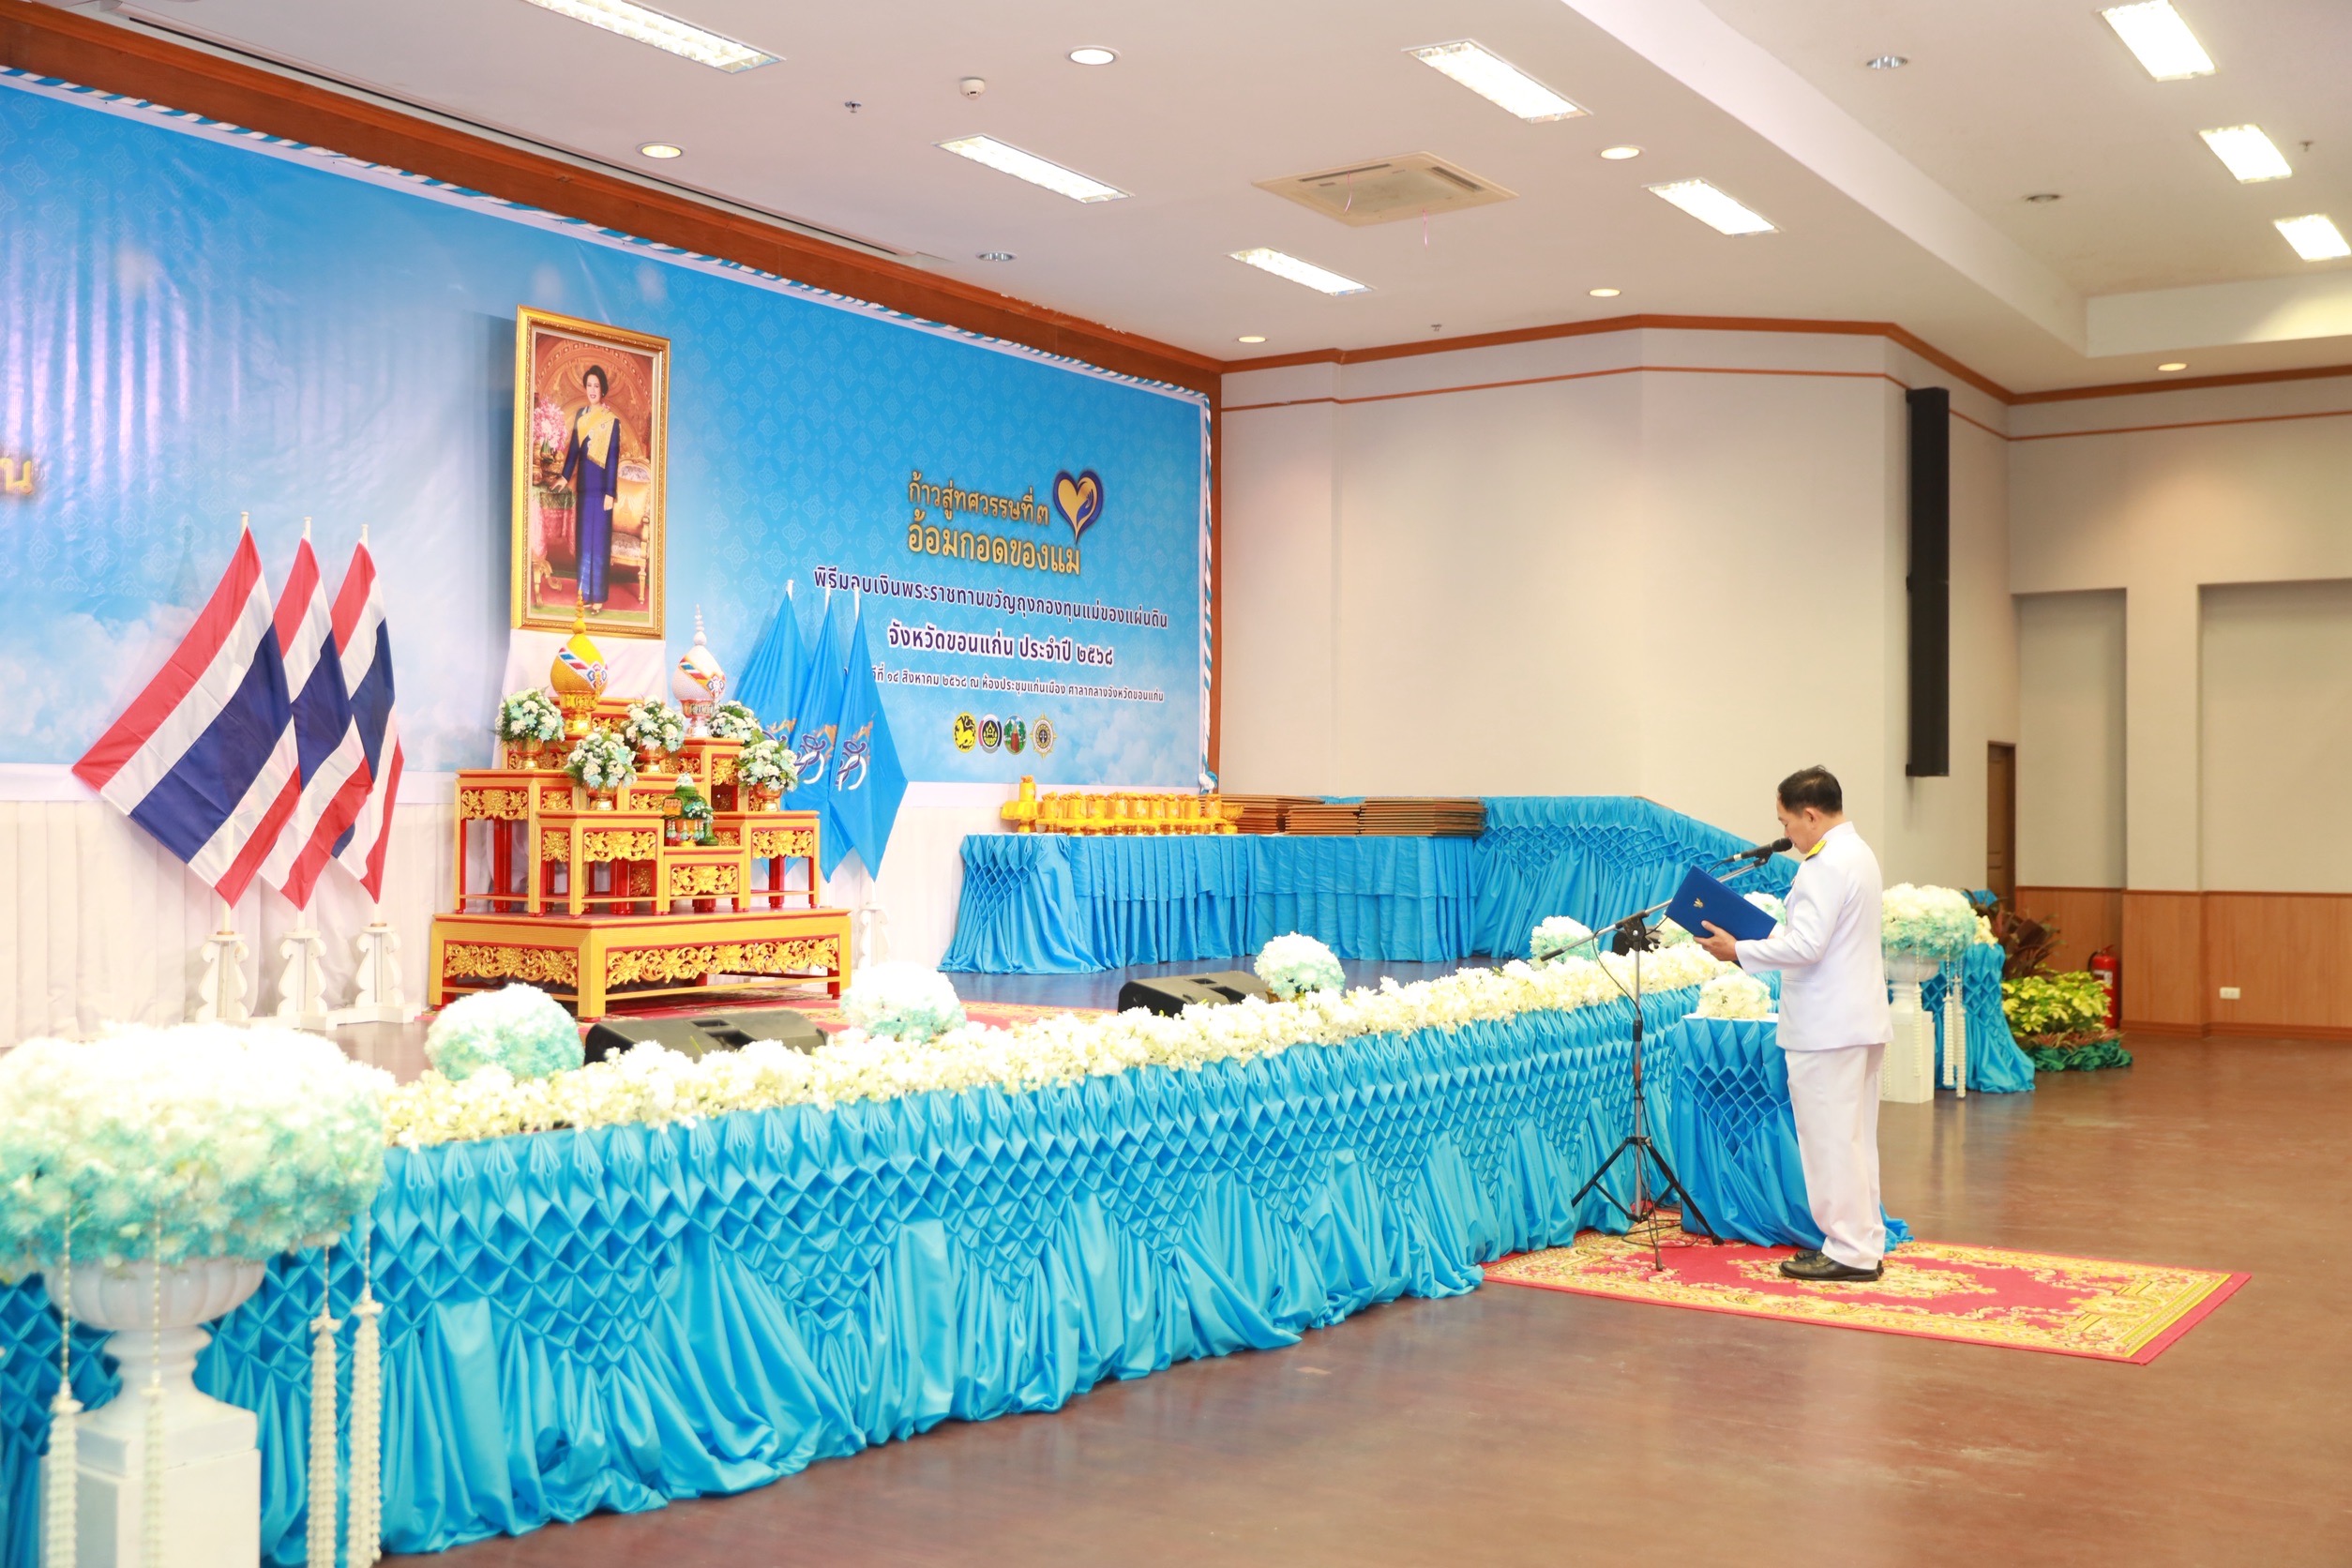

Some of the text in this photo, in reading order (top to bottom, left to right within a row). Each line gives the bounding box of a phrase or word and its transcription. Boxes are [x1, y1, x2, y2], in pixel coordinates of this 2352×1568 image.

[889, 622, 1013, 656] จังหวัดขอนแก่น
[1019, 637, 1071, 661] ประจำปี
[901, 670, 940, 686] สิงหาคม
